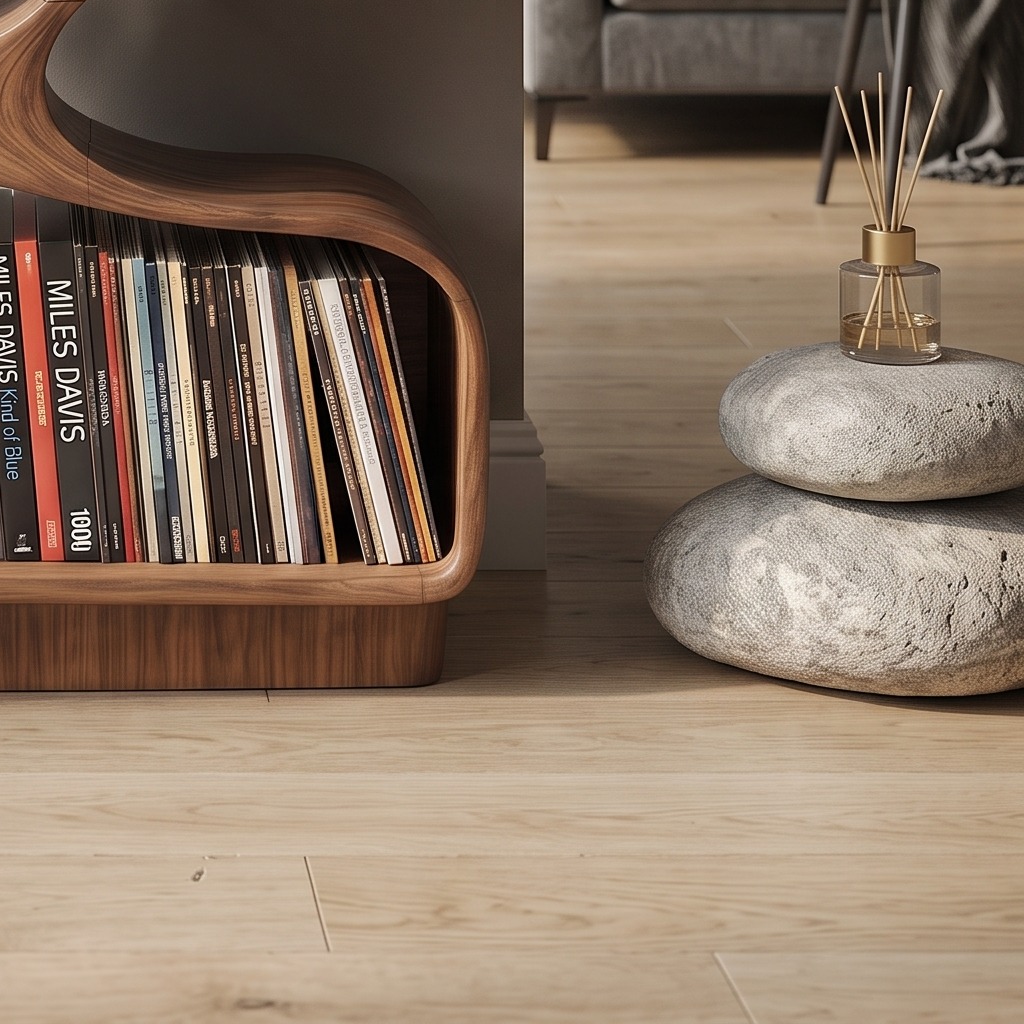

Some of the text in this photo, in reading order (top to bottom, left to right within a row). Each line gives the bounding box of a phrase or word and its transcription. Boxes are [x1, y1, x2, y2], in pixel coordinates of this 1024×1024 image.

[46, 280, 86, 443] MILES DAVIS
[0, 389, 20, 422] Kind
[3, 427, 21, 441] of
[4, 446, 23, 480] Blue
